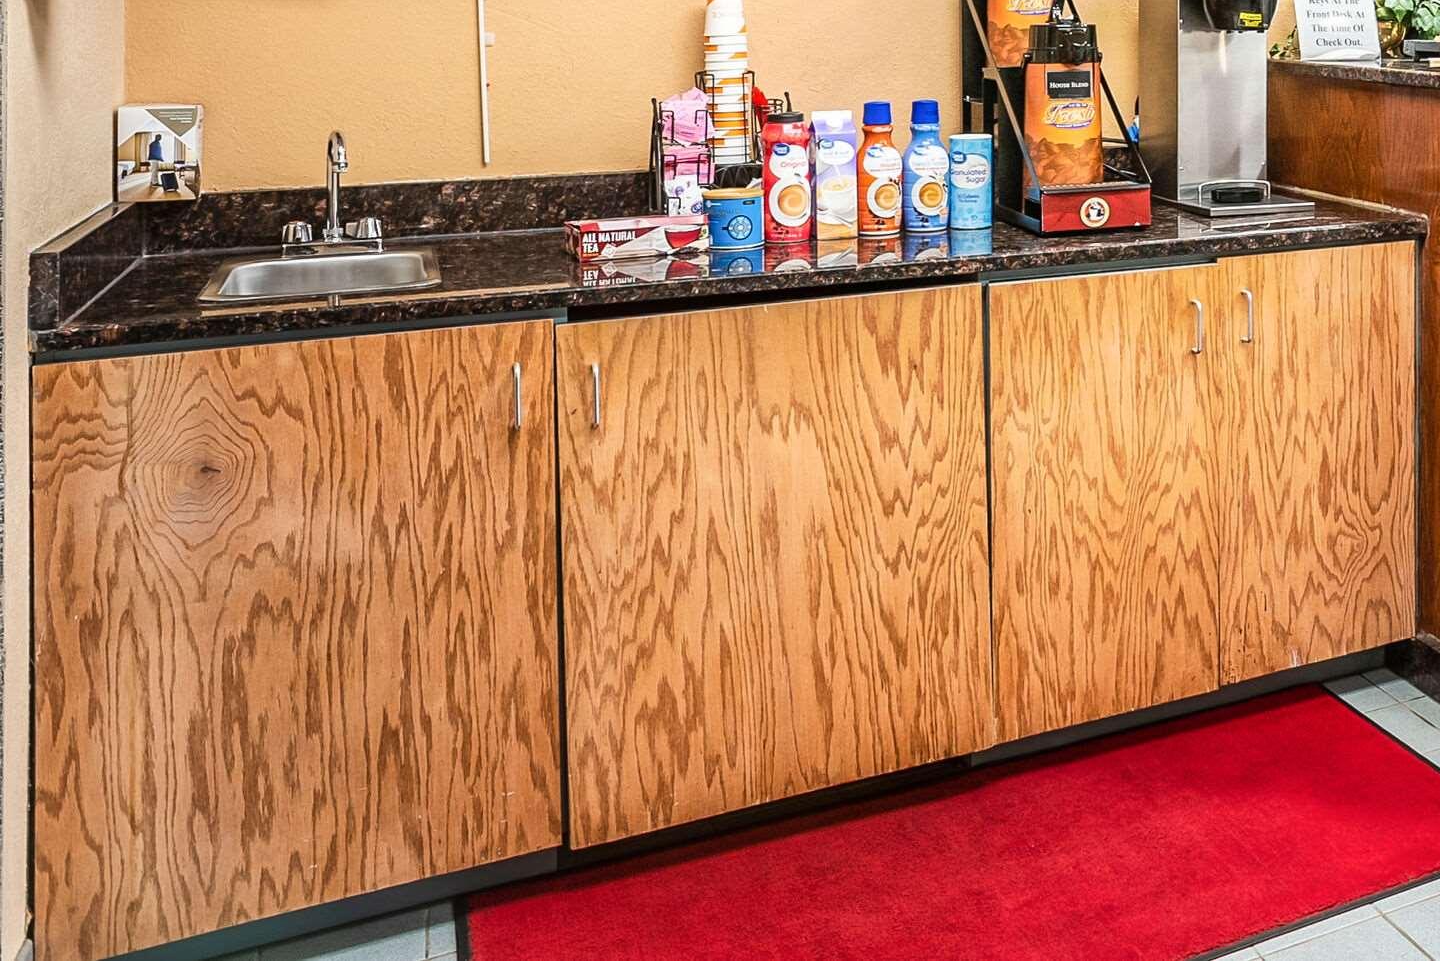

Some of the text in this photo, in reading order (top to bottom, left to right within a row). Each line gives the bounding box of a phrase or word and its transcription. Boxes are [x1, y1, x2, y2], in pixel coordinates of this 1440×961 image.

[1307, 10, 1330, 19] Front
[1356, 11, 1365, 19] At
[1312, 23, 1328, 32] The
[1352, 23, 1364, 32] Of
[1315, 38, 1342, 47] Check
[583, 230, 637, 243] ALL NATURAL
[583, 243, 599, 254] TEA
